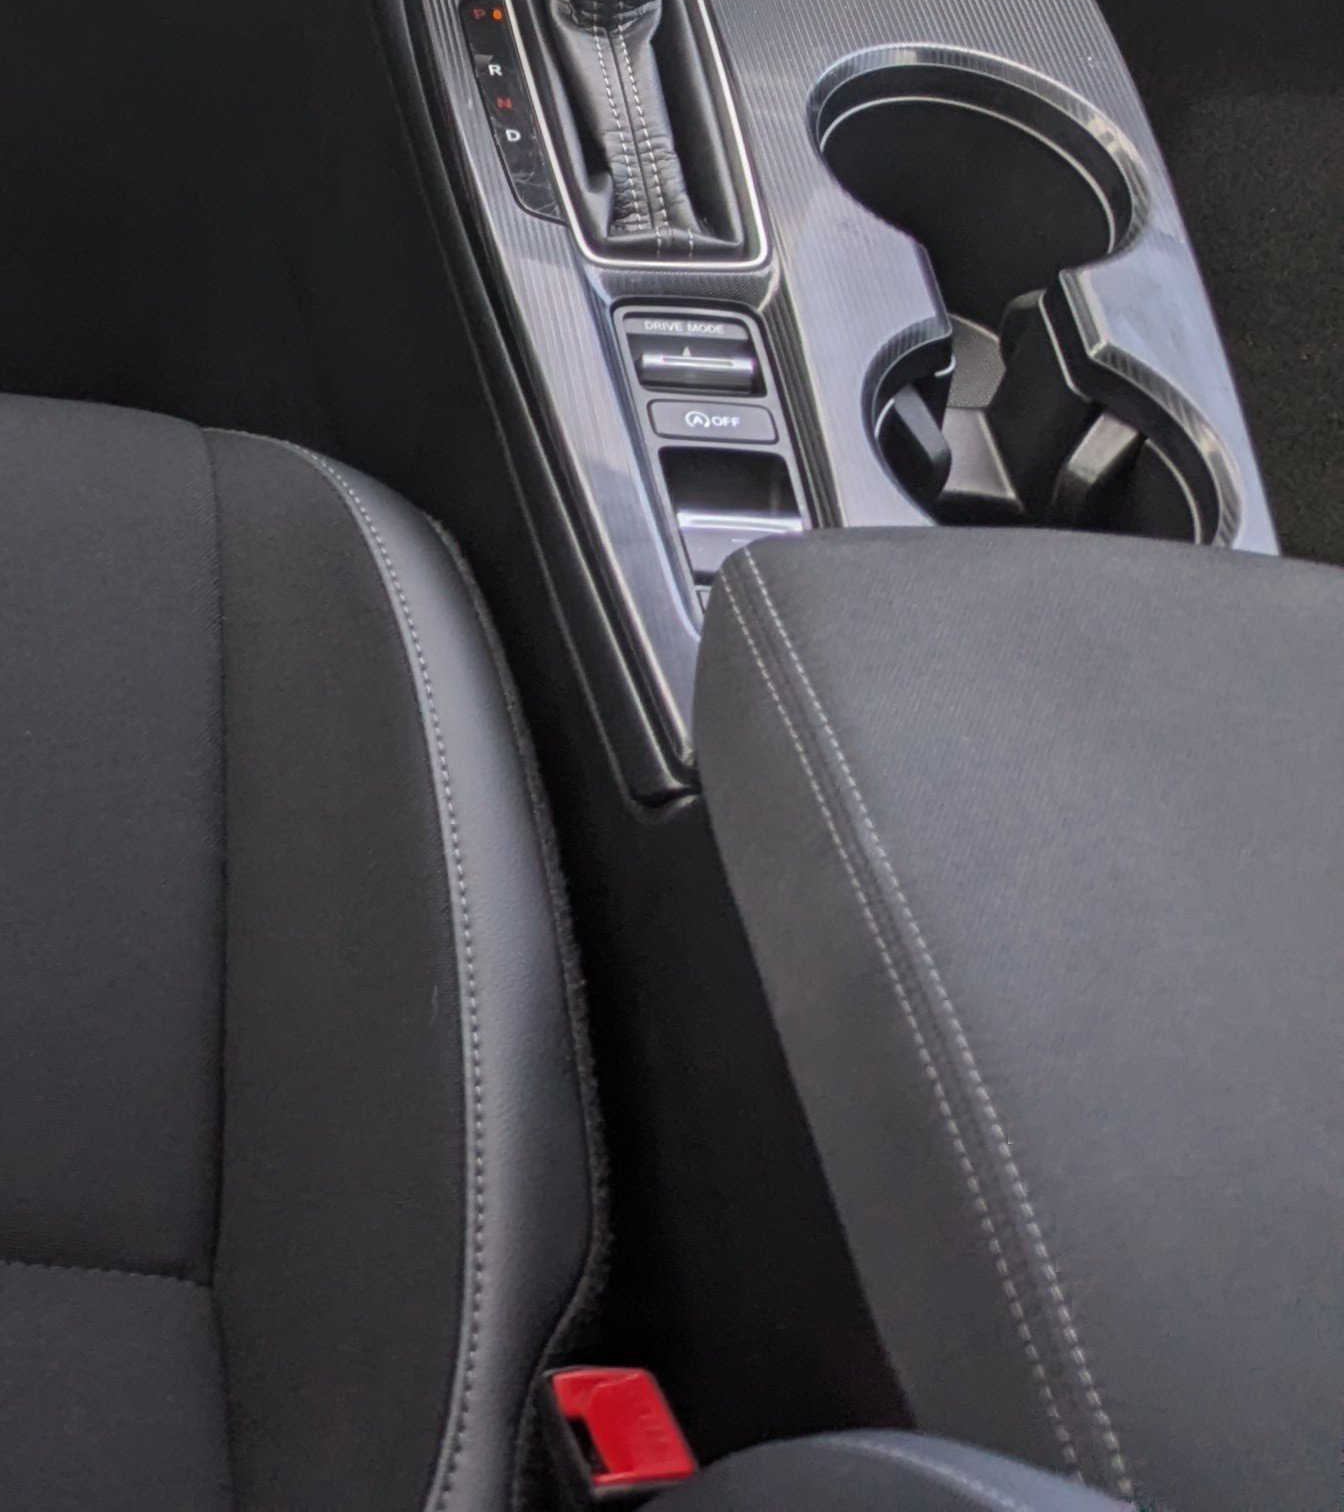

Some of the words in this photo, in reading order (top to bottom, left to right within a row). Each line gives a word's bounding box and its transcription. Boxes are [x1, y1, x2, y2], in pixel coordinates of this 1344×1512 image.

[488, 63, 503, 76] R
[505, 128, 522, 142] D
[644, 320, 683, 332] DRIVE
[687, 324, 724, 334] MODE
[712, 416, 740, 428] OFF
